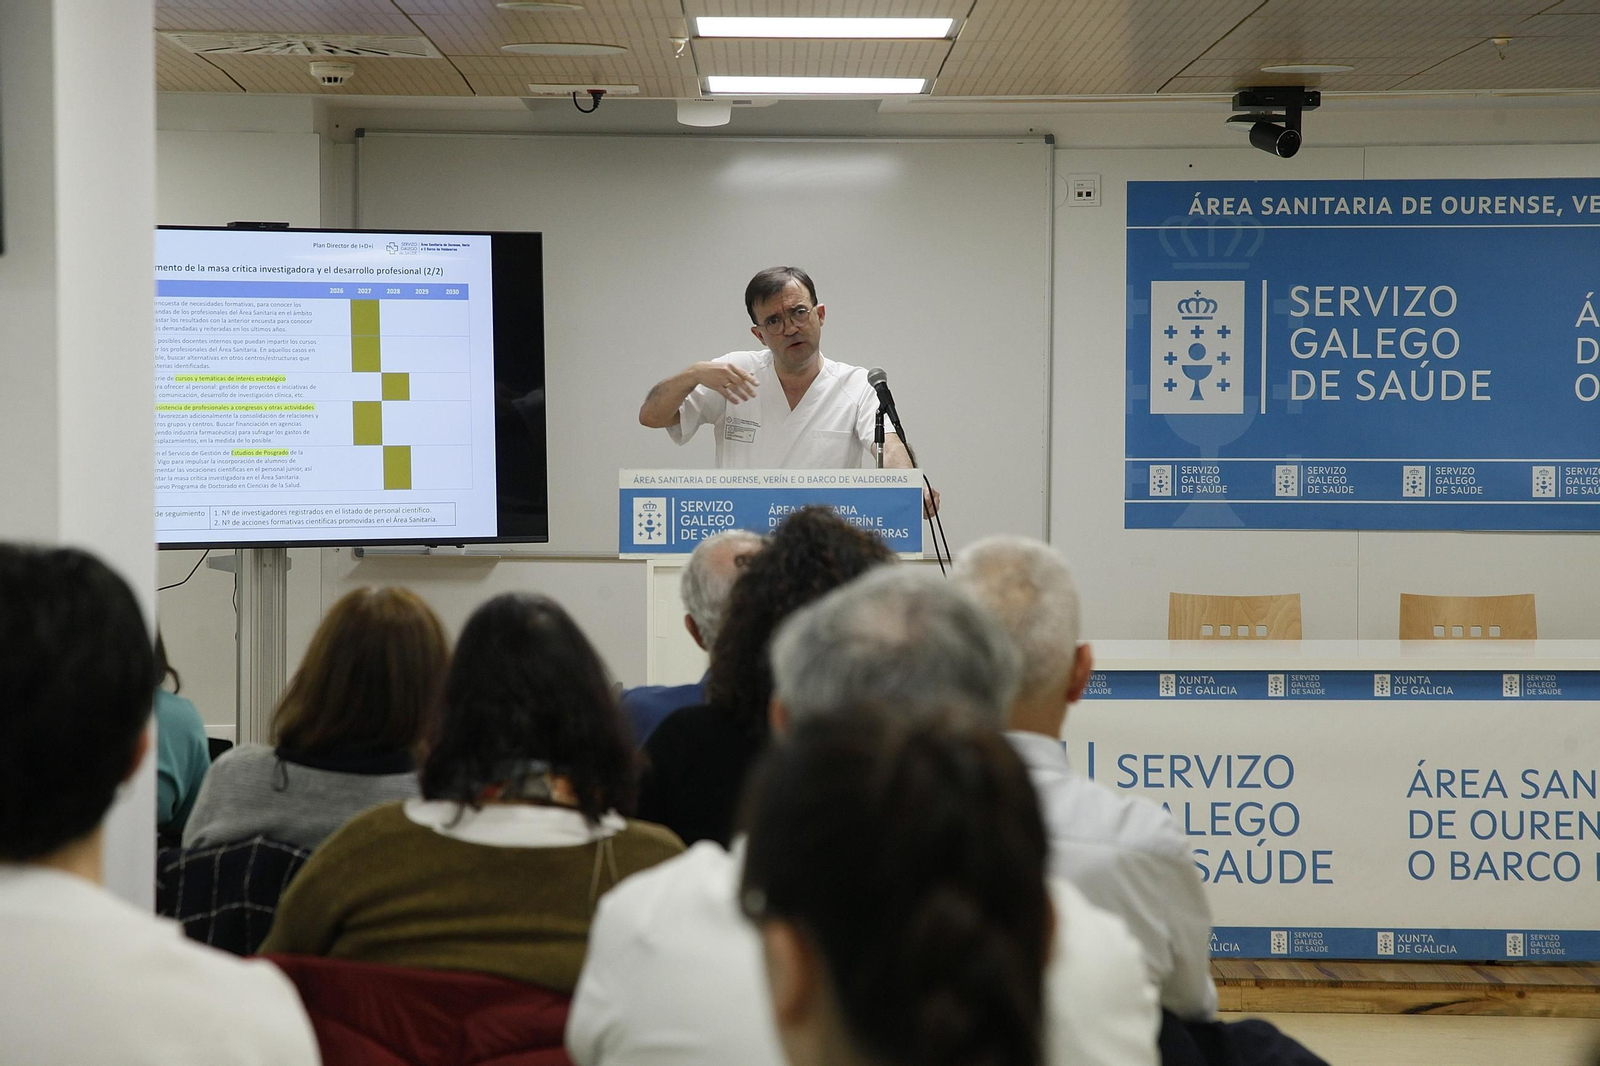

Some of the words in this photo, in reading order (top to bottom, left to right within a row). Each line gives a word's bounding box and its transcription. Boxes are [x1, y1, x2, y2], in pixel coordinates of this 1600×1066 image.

[1188, 193, 1253, 215] ÁREA
[1261, 196, 1392, 214] SANITARIA
[1402, 197, 1432, 214] DE
[1441, 196, 1563, 217] OURENSE,
[260, 265, 314, 275] investigadora
[376, 267, 422, 276] profesional
[424, 268, 444, 276] (2/2)
[1290, 286, 1458, 318] SERVIZO
[1290, 328, 1460, 360] GALEGO
[1291, 370, 1340, 400] DE
[1356, 360, 1492, 401] SAÚDE
[1181, 466, 1220, 474] SERVIZO
[1308, 466, 1346, 474] SERVIZO
[1436, 467, 1475, 475] SERVIZO
[634, 474, 656, 484] ÁREA
[658, 476, 704, 484] SANITARIA
[719, 476, 761, 486] OURENSE,
[764, 474, 788, 484] VERÍN
[808, 476, 836, 484] BARCO
[852, 476, 908, 484] VALDEORRAS
[1181, 476, 1220, 484] GALEGO
[1308, 476, 1348, 484] GALEGO
[1436, 477, 1476, 485] GALEGO
[1181, 486, 1192, 494] DE
[1194, 484, 1227, 494] SAÚDE
[1308, 486, 1319, 494] DE
[1321, 484, 1354, 494] SAÚDE
[1436, 486, 1448, 495] DE
[1450, 484, 1483, 495] SAÚDE
[1566, 486, 1578, 494] DE
[680, 500, 734, 512] SERVIZO
[768, 503, 796, 514] ÁREA
[165, 510, 205, 518] seguimiento
[242, 508, 288, 518] investigadores
[289, 508, 324, 517] registrados
[374, 507, 400, 515] personal
[339, 517, 375, 525] promovidas
[680, 515, 735, 526] GALEGO
[876, 517, 883, 526] E
[681, 529, 698, 540] DE
[1178, 676, 1216, 684] XUNTA
[1394, 676, 1431, 684] XUNTA
[1178, 686, 1192, 695] DE
[1196, 686, 1238, 695] GALICIA
[1394, 686, 1408, 695] DE
[1410, 686, 1454, 695] GALICIA
[1116, 754, 1294, 789] SERVIZO
[1406, 759, 1508, 798] ÁREA
[1162, 802, 1300, 836] LEGO
[1409, 810, 1457, 839] DE
[1192, 838, 1334, 884] SAÚDE
[1408, 850, 1435, 880] O
[1450, 851, 1581, 882] BARCO
[1398, 934, 1434, 943] XUNTA
[1208, 942, 1240, 952] ALICIA
[1398, 944, 1411, 953] DE
[1414, 945, 1458, 954] GALICIA
